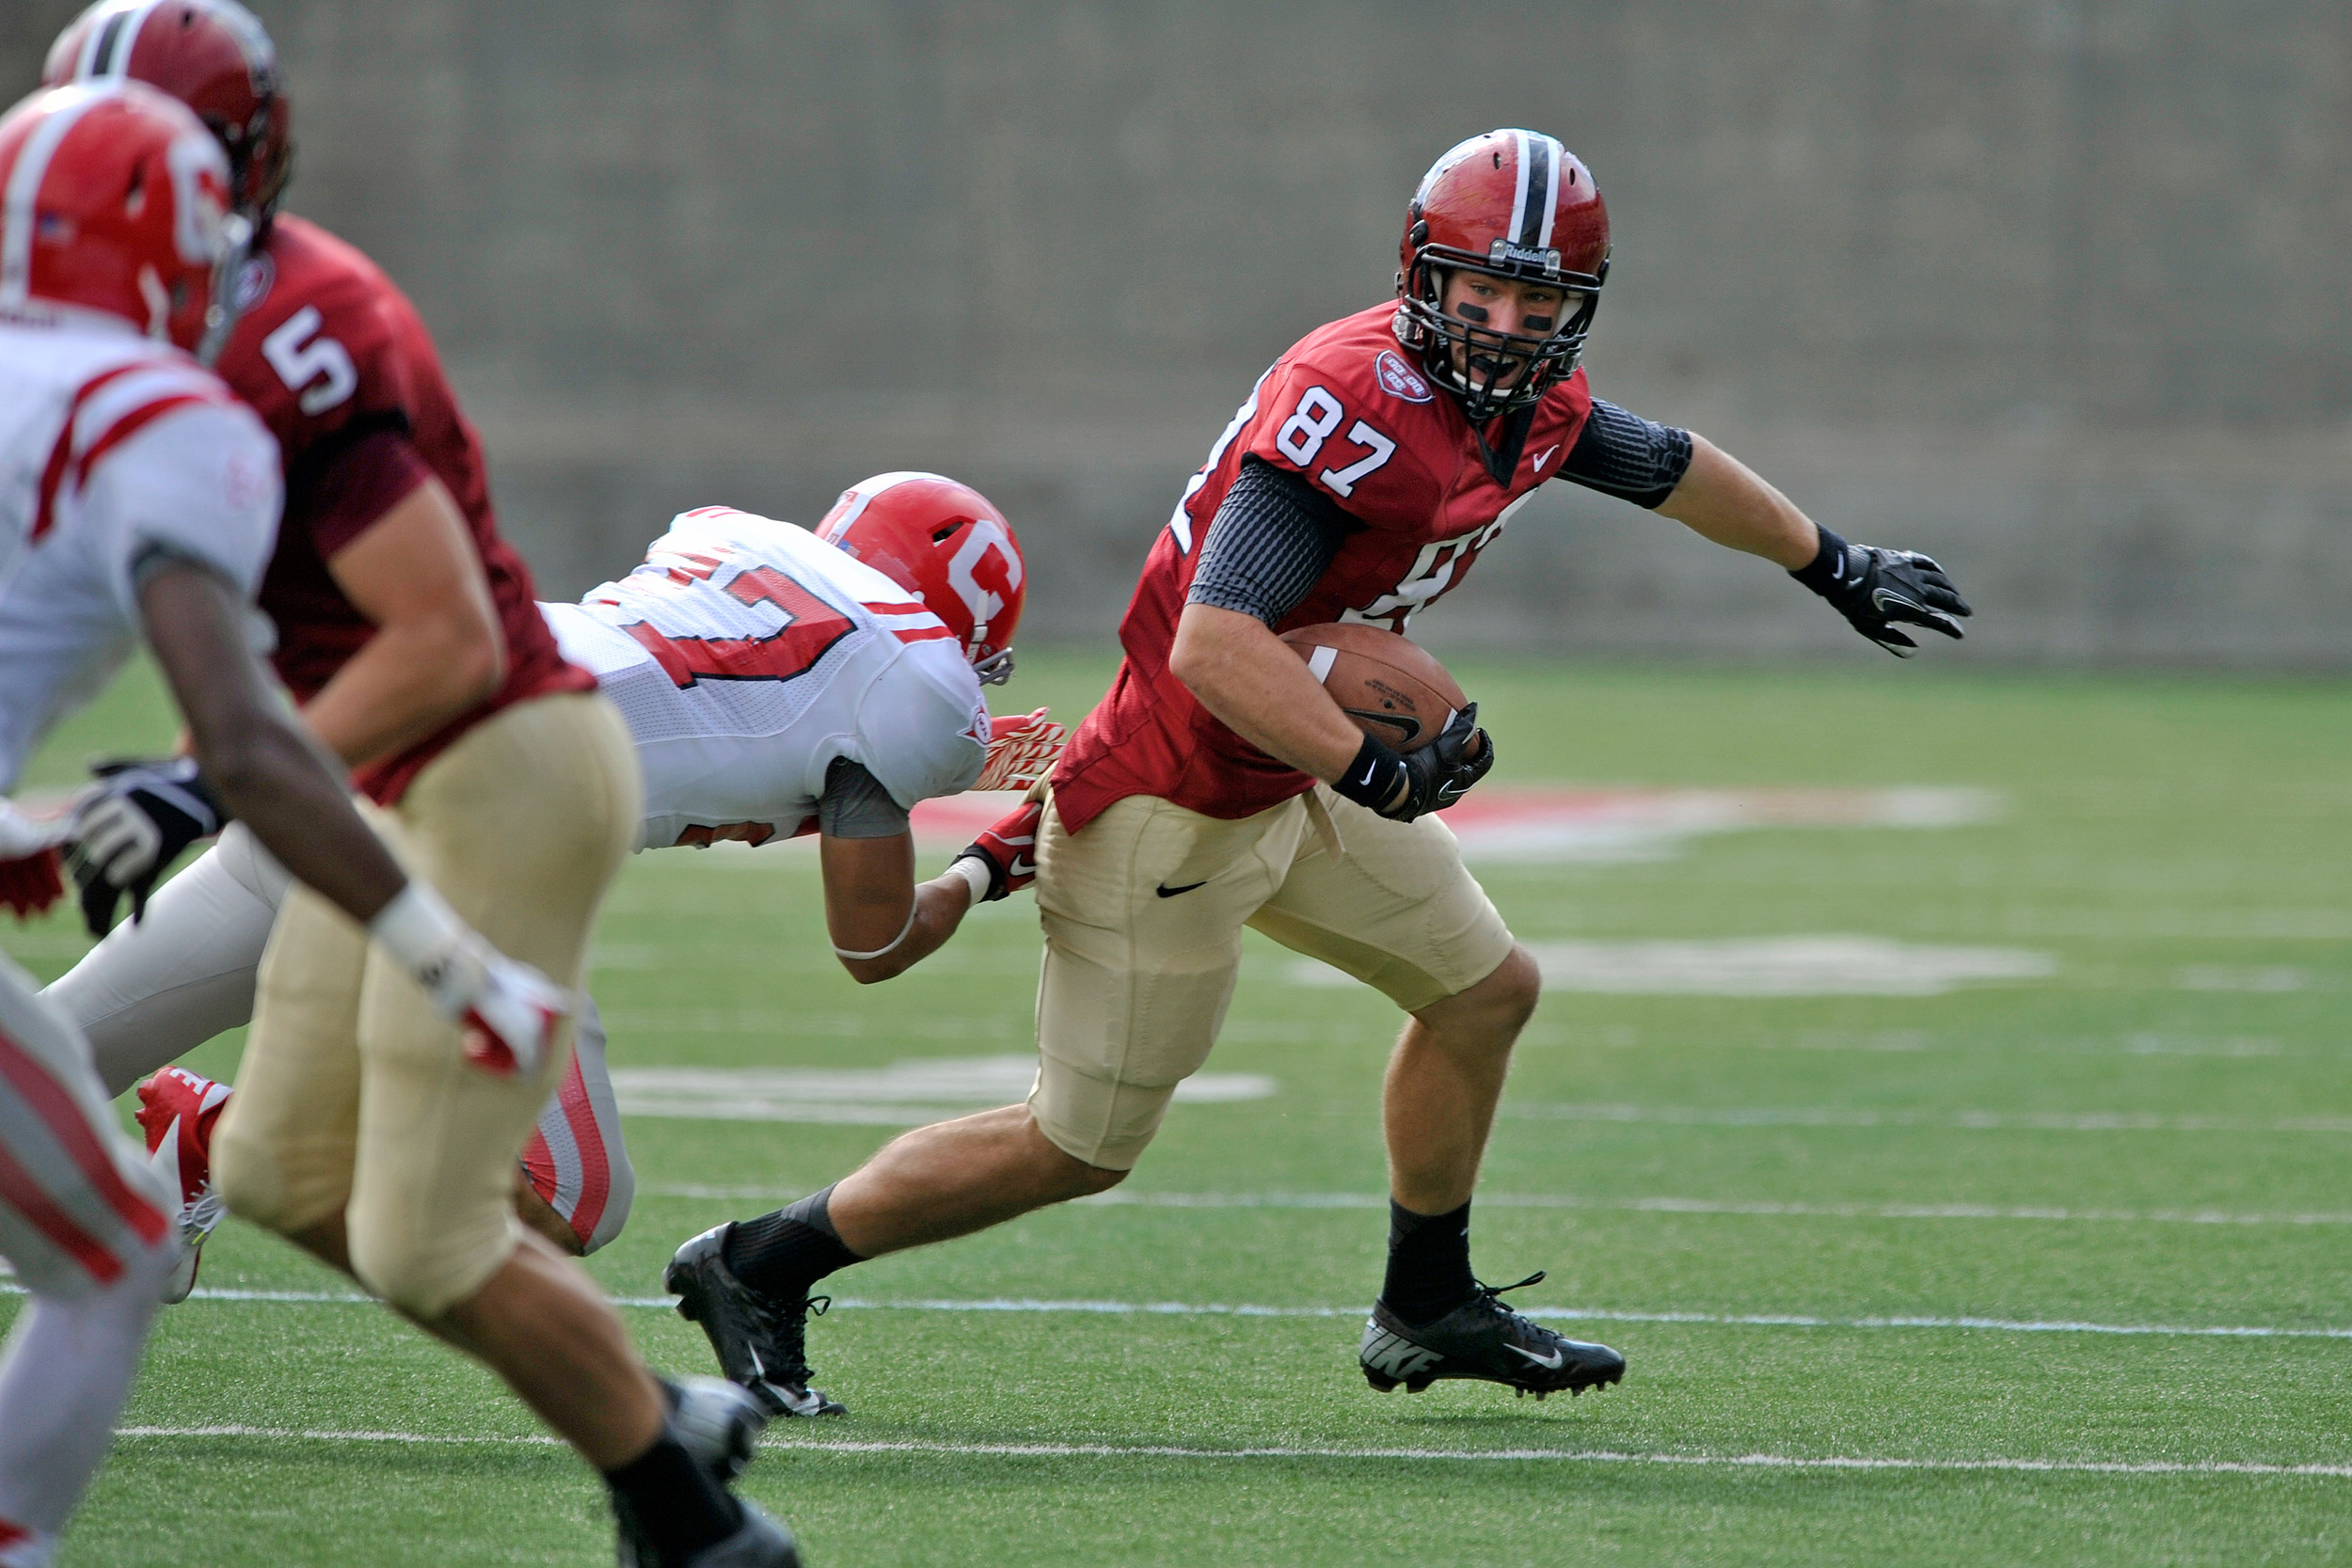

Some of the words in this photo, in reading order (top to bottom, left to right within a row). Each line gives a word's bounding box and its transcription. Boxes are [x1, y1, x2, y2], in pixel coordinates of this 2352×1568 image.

[1505, 244, 1547, 263] Riddell
[261, 304, 358, 417] 5
[1276, 385, 1397, 499] 87
[946, 519, 1023, 621] C
